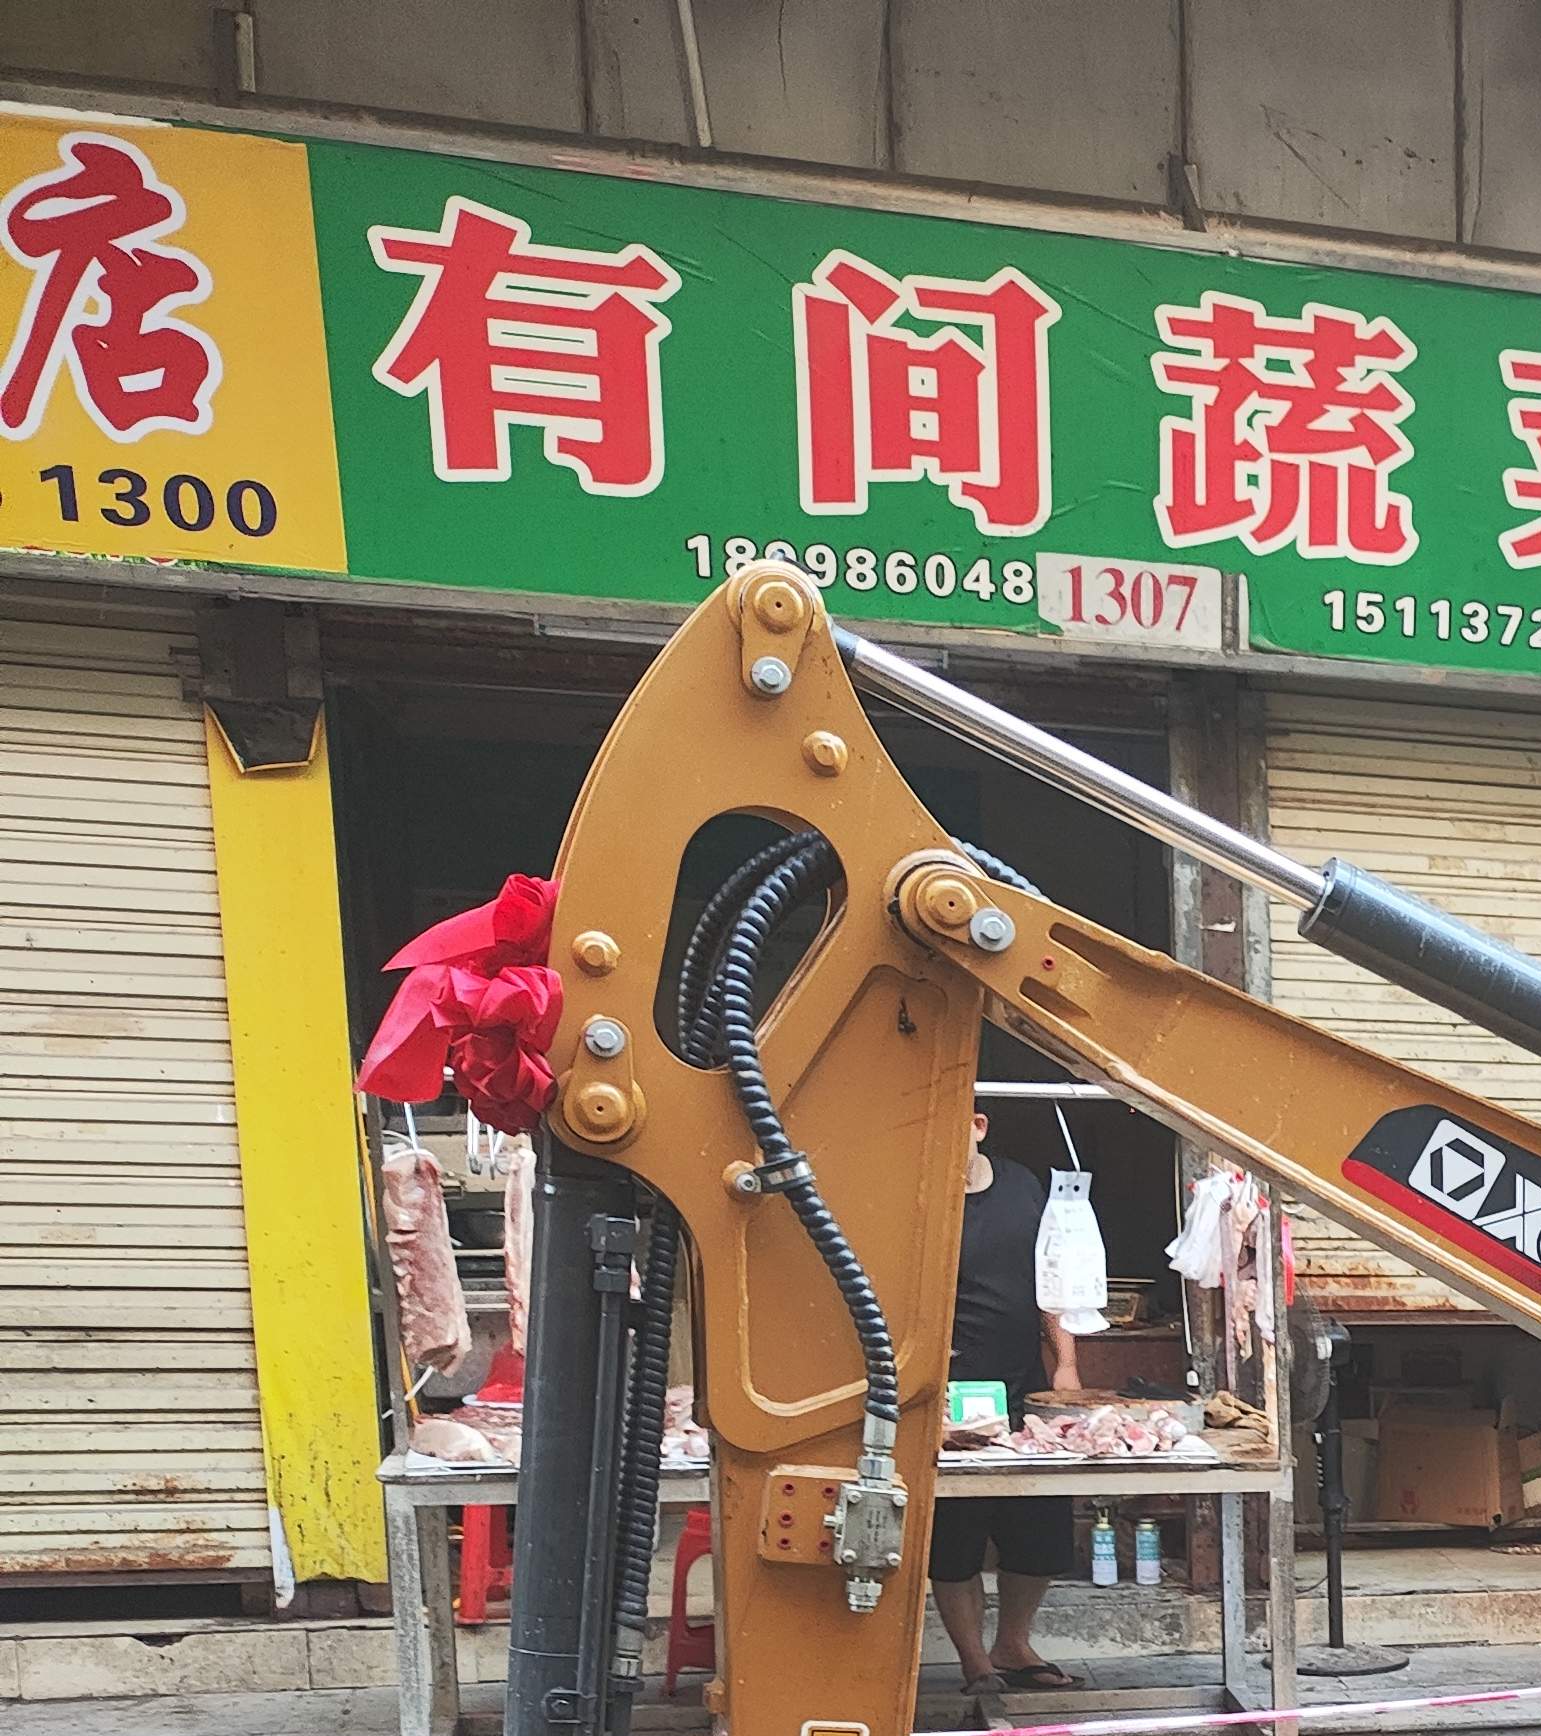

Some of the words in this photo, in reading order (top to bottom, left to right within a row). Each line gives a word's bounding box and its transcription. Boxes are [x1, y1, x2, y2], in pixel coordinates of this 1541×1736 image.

[0, 131, 223, 441] 店
[39, 464, 278, 537] 1300
[686, 534, 1034, 603] 18986048
[1063, 565, 1198, 632] 1307
